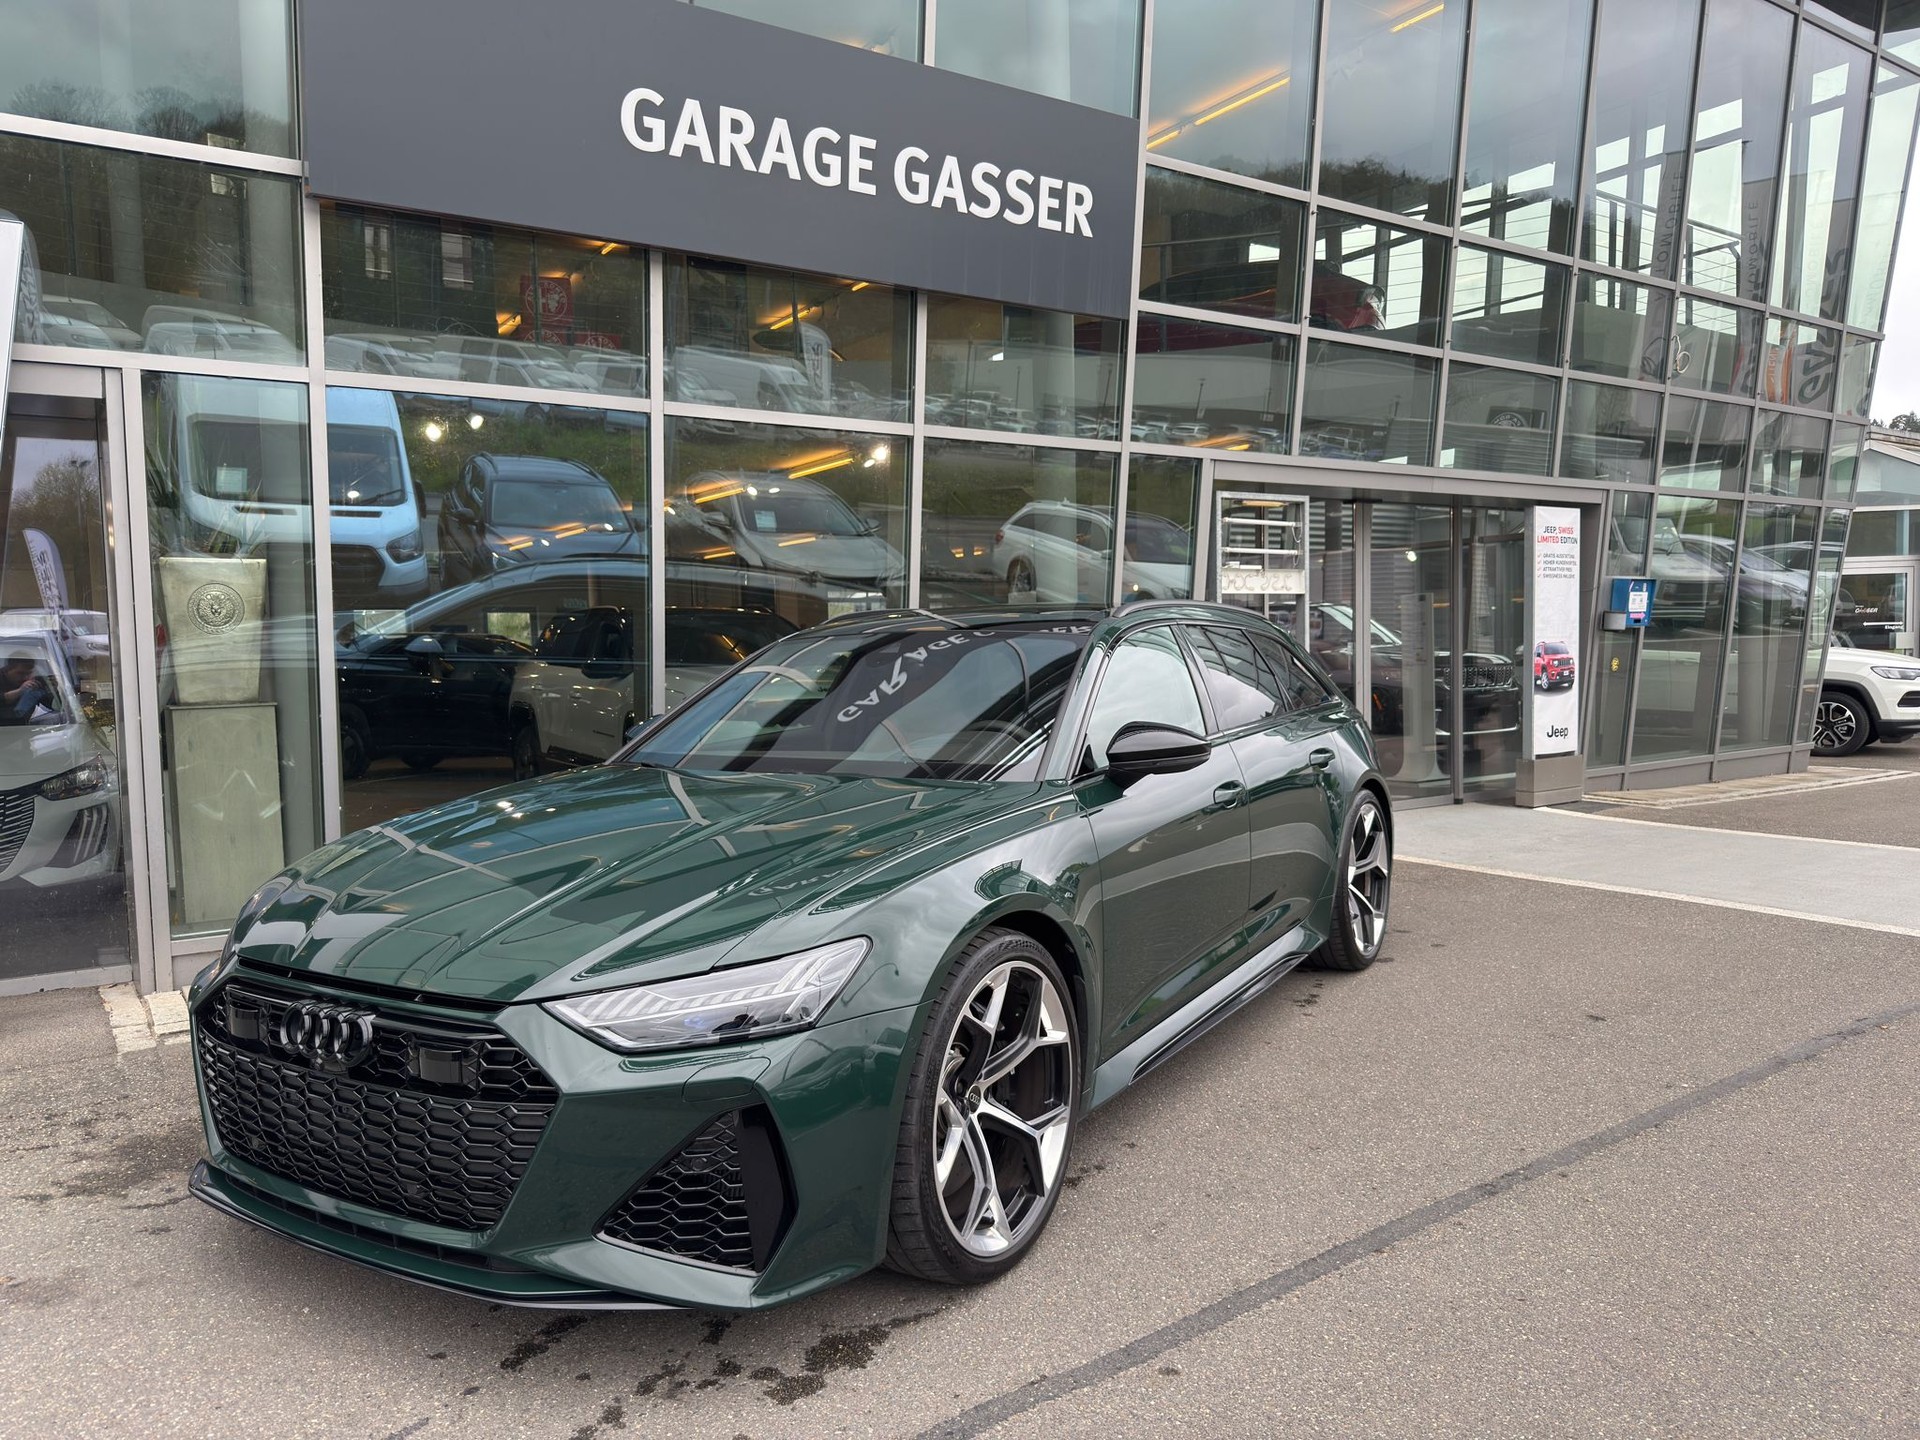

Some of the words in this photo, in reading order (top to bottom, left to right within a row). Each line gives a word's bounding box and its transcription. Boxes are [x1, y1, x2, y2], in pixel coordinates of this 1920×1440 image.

[619, 86, 878, 196] GARAGE
[893, 145, 1094, 238] GASSER
[1546, 724, 1569, 739] Jeep
